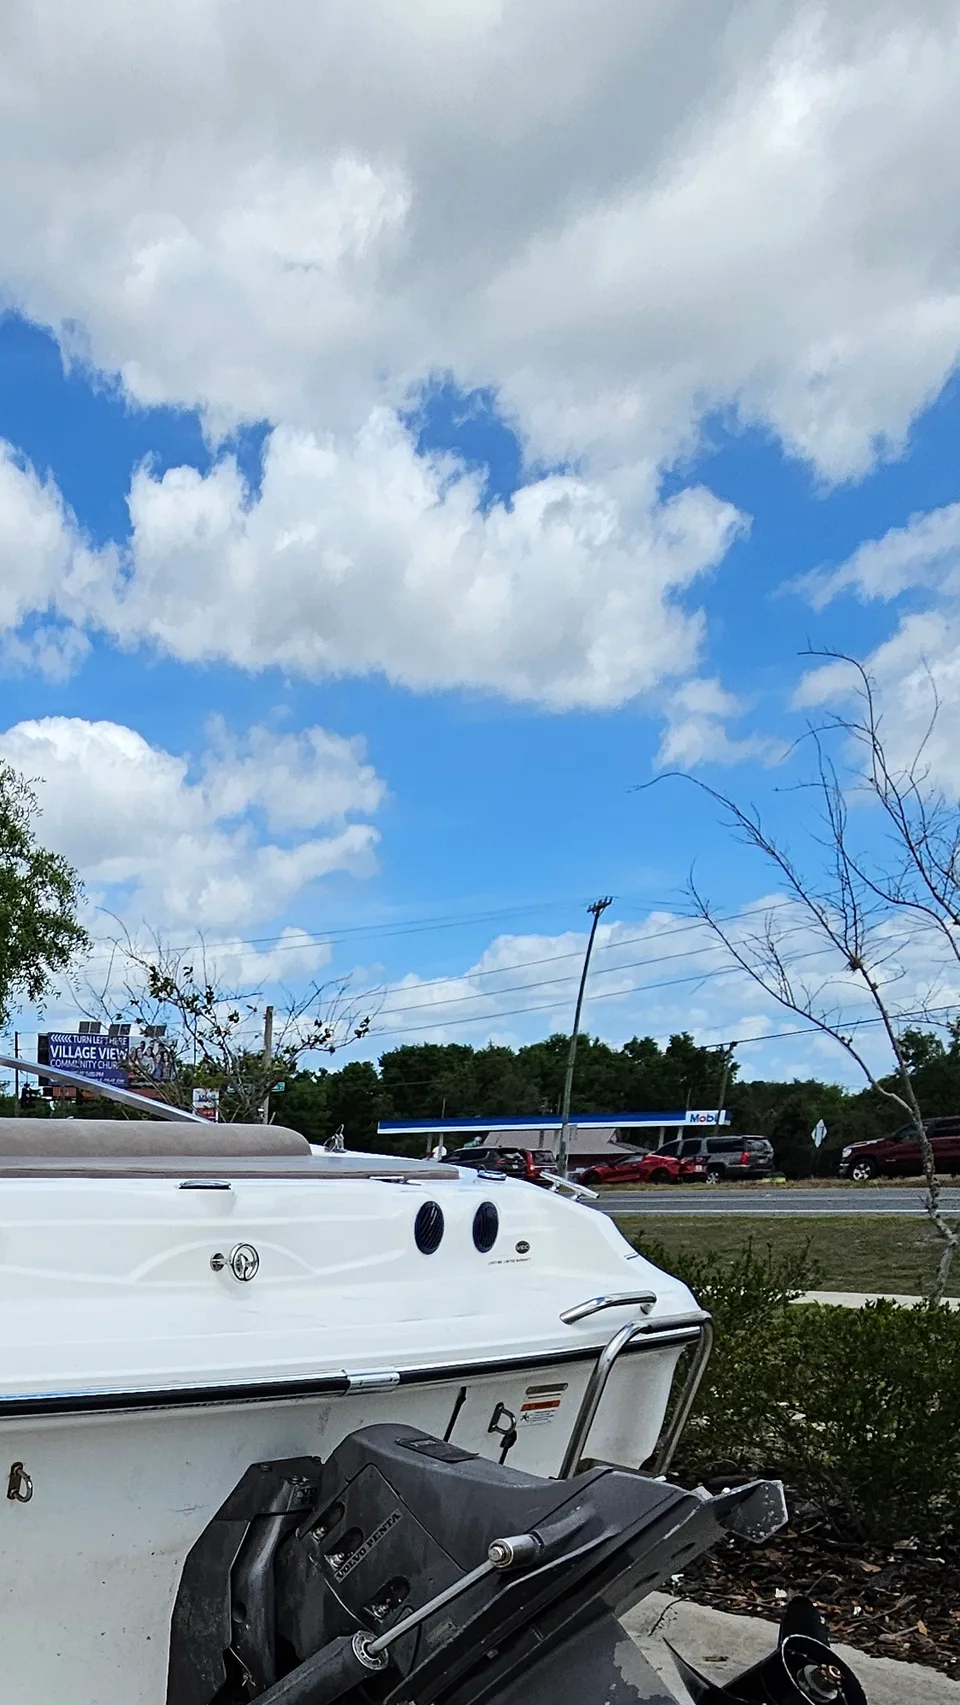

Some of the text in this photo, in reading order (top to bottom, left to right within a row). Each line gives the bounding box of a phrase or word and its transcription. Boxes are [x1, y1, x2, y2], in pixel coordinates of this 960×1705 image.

[73, 1035, 92, 1044] TURN
[50, 1045, 128, 1061] VILLAGE VIEW
[690, 1113, 719, 1123] Mobi
[336, 1511, 402, 1580] VOLVO PENTA
